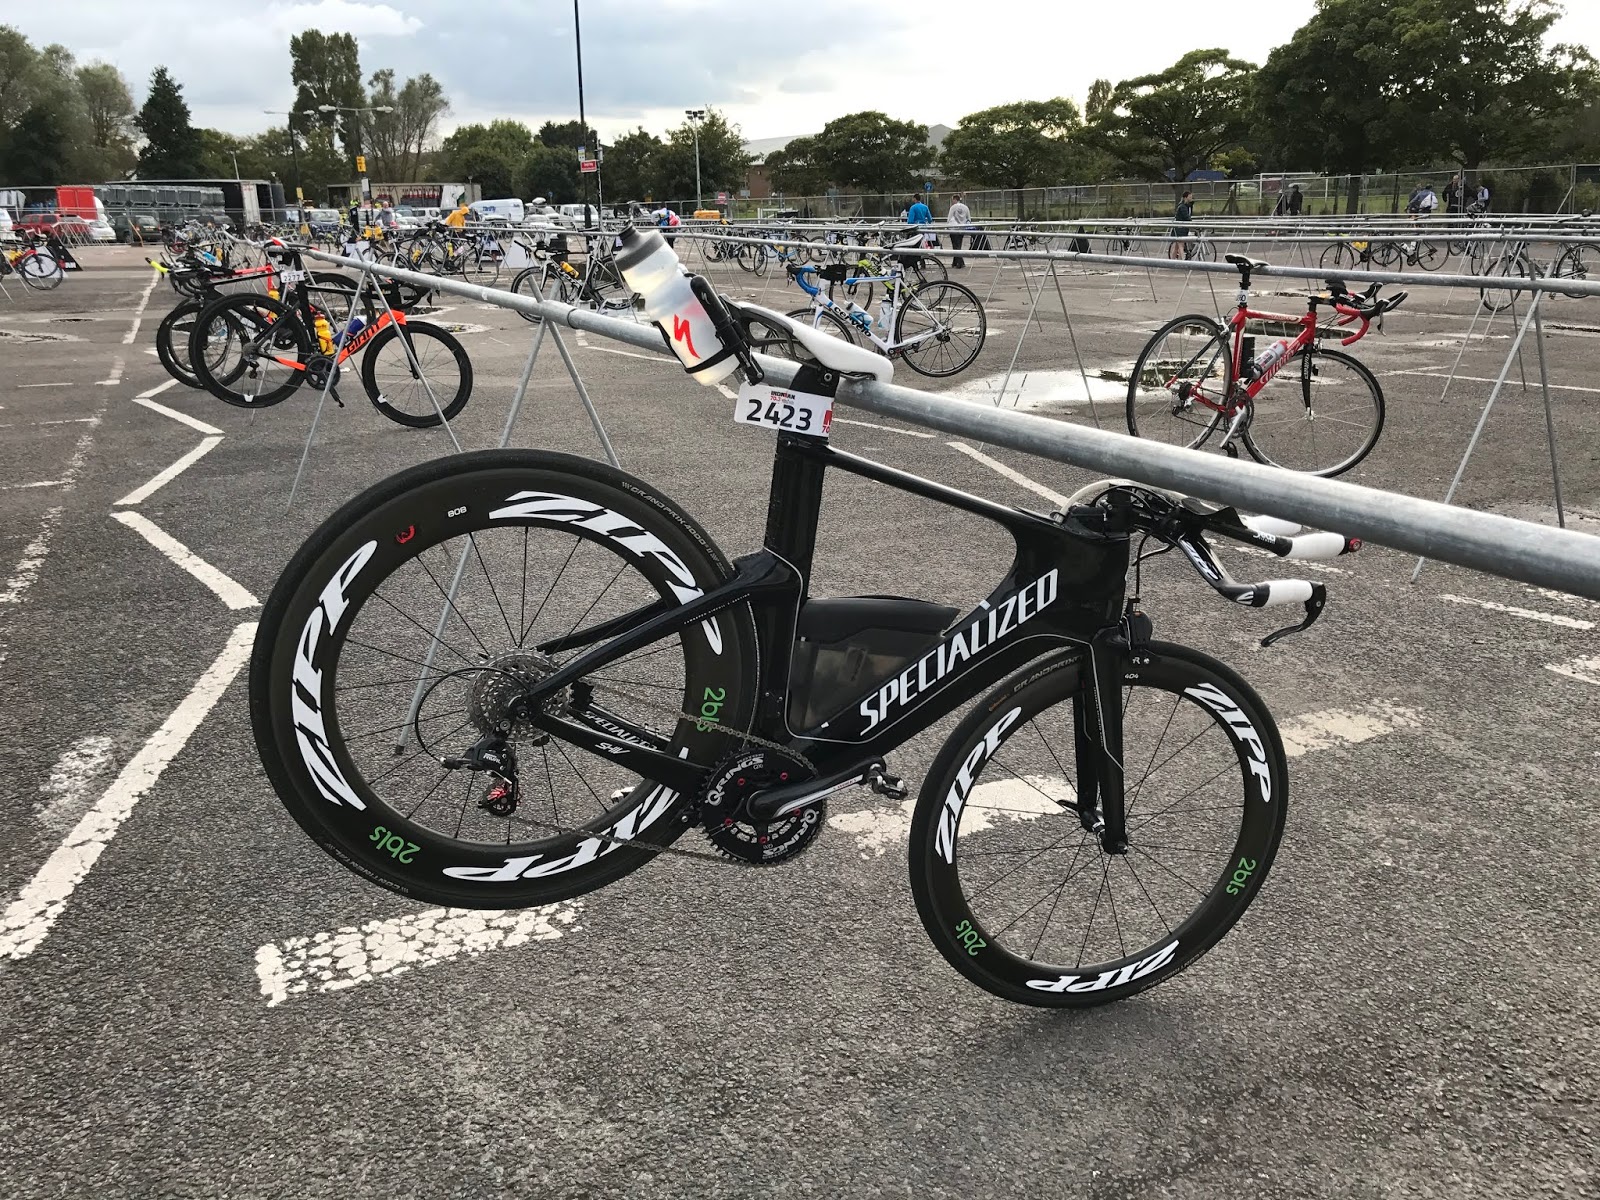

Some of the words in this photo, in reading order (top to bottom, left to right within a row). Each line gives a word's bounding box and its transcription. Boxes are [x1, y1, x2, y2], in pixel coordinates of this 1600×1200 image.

[346, 324, 380, 354] GIANT
[746, 398, 813, 431] 2423
[488, 490, 723, 655] ZIPP
[291, 540, 378, 811] ZIPP
[859, 568, 1059, 737] SPECIALIZED
[935, 706, 1022, 865] ZIPP
[1184, 682, 1273, 803] ZIPP
[1025, 939, 1181, 993] ZIPP
